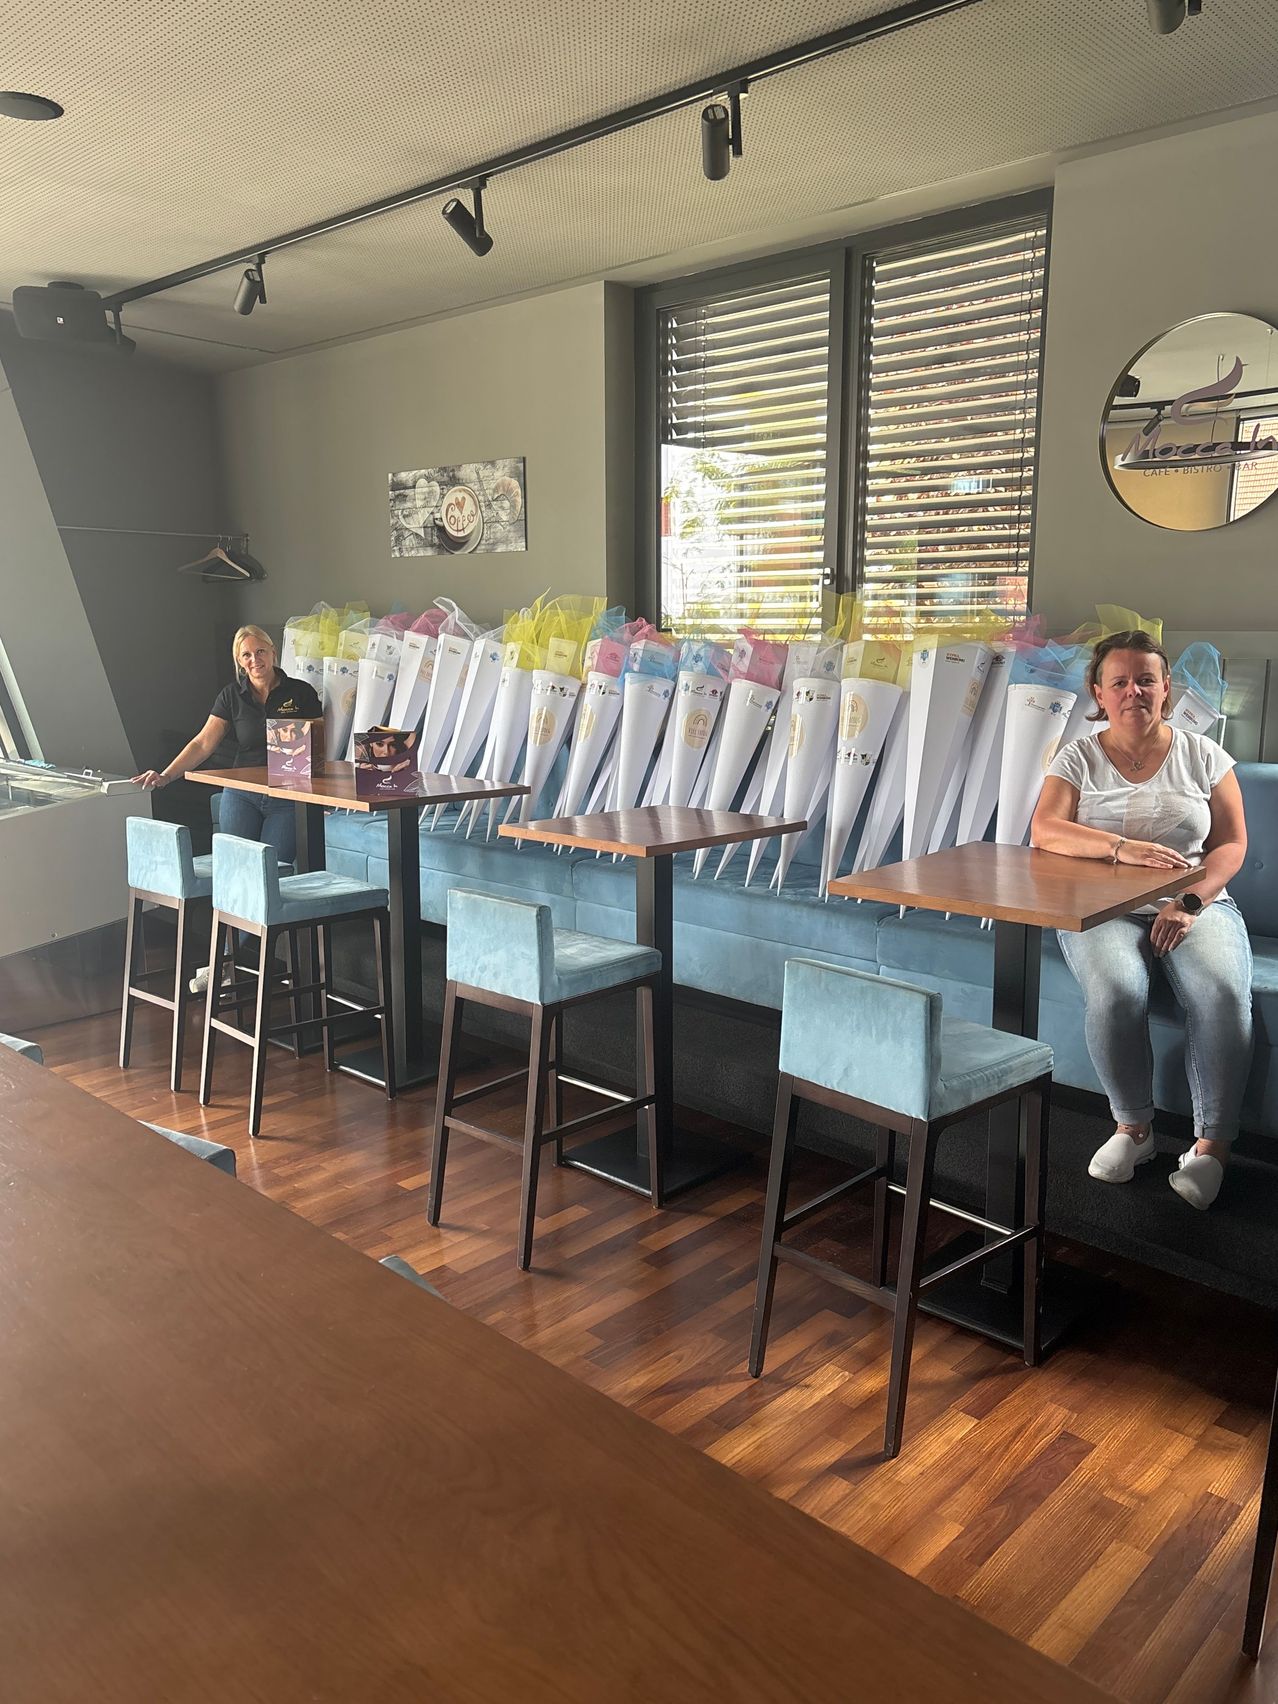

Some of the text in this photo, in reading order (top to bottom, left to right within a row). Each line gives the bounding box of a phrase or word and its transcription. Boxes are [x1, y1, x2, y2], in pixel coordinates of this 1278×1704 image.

[1121, 423, 1278, 461] Mocca In
[1183, 464, 1222, 475] BISTRO
[1235, 461, 1258, 471] BAR
[445, 502, 477, 535] Coffee
